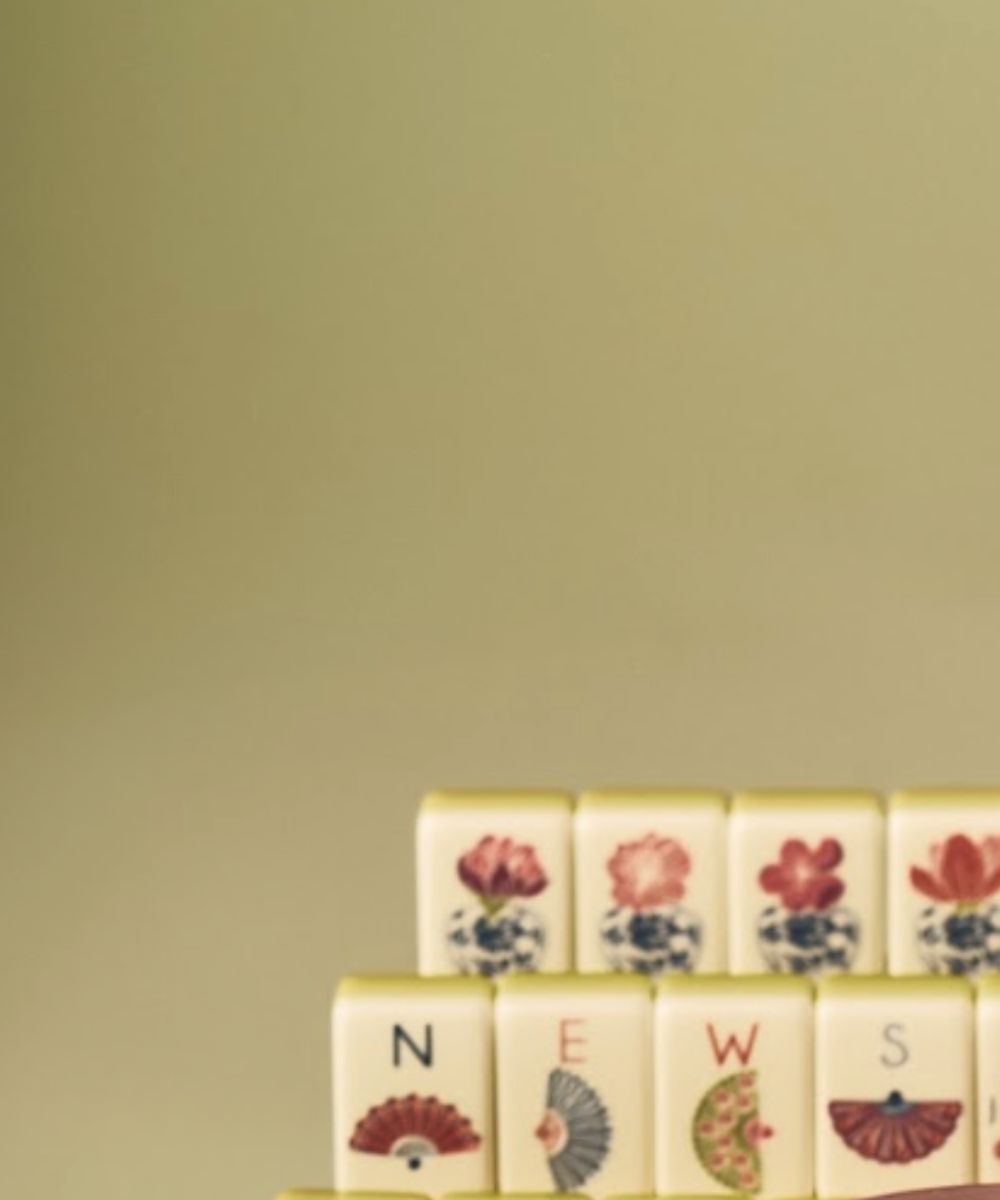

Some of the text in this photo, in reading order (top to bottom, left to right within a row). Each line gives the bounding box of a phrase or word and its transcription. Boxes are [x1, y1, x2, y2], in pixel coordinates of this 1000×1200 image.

[393, 1025, 433, 1067] N
[559, 1020, 587, 1064] E
[707, 1024, 759, 1066] W
[881, 1024, 909, 1067] S
